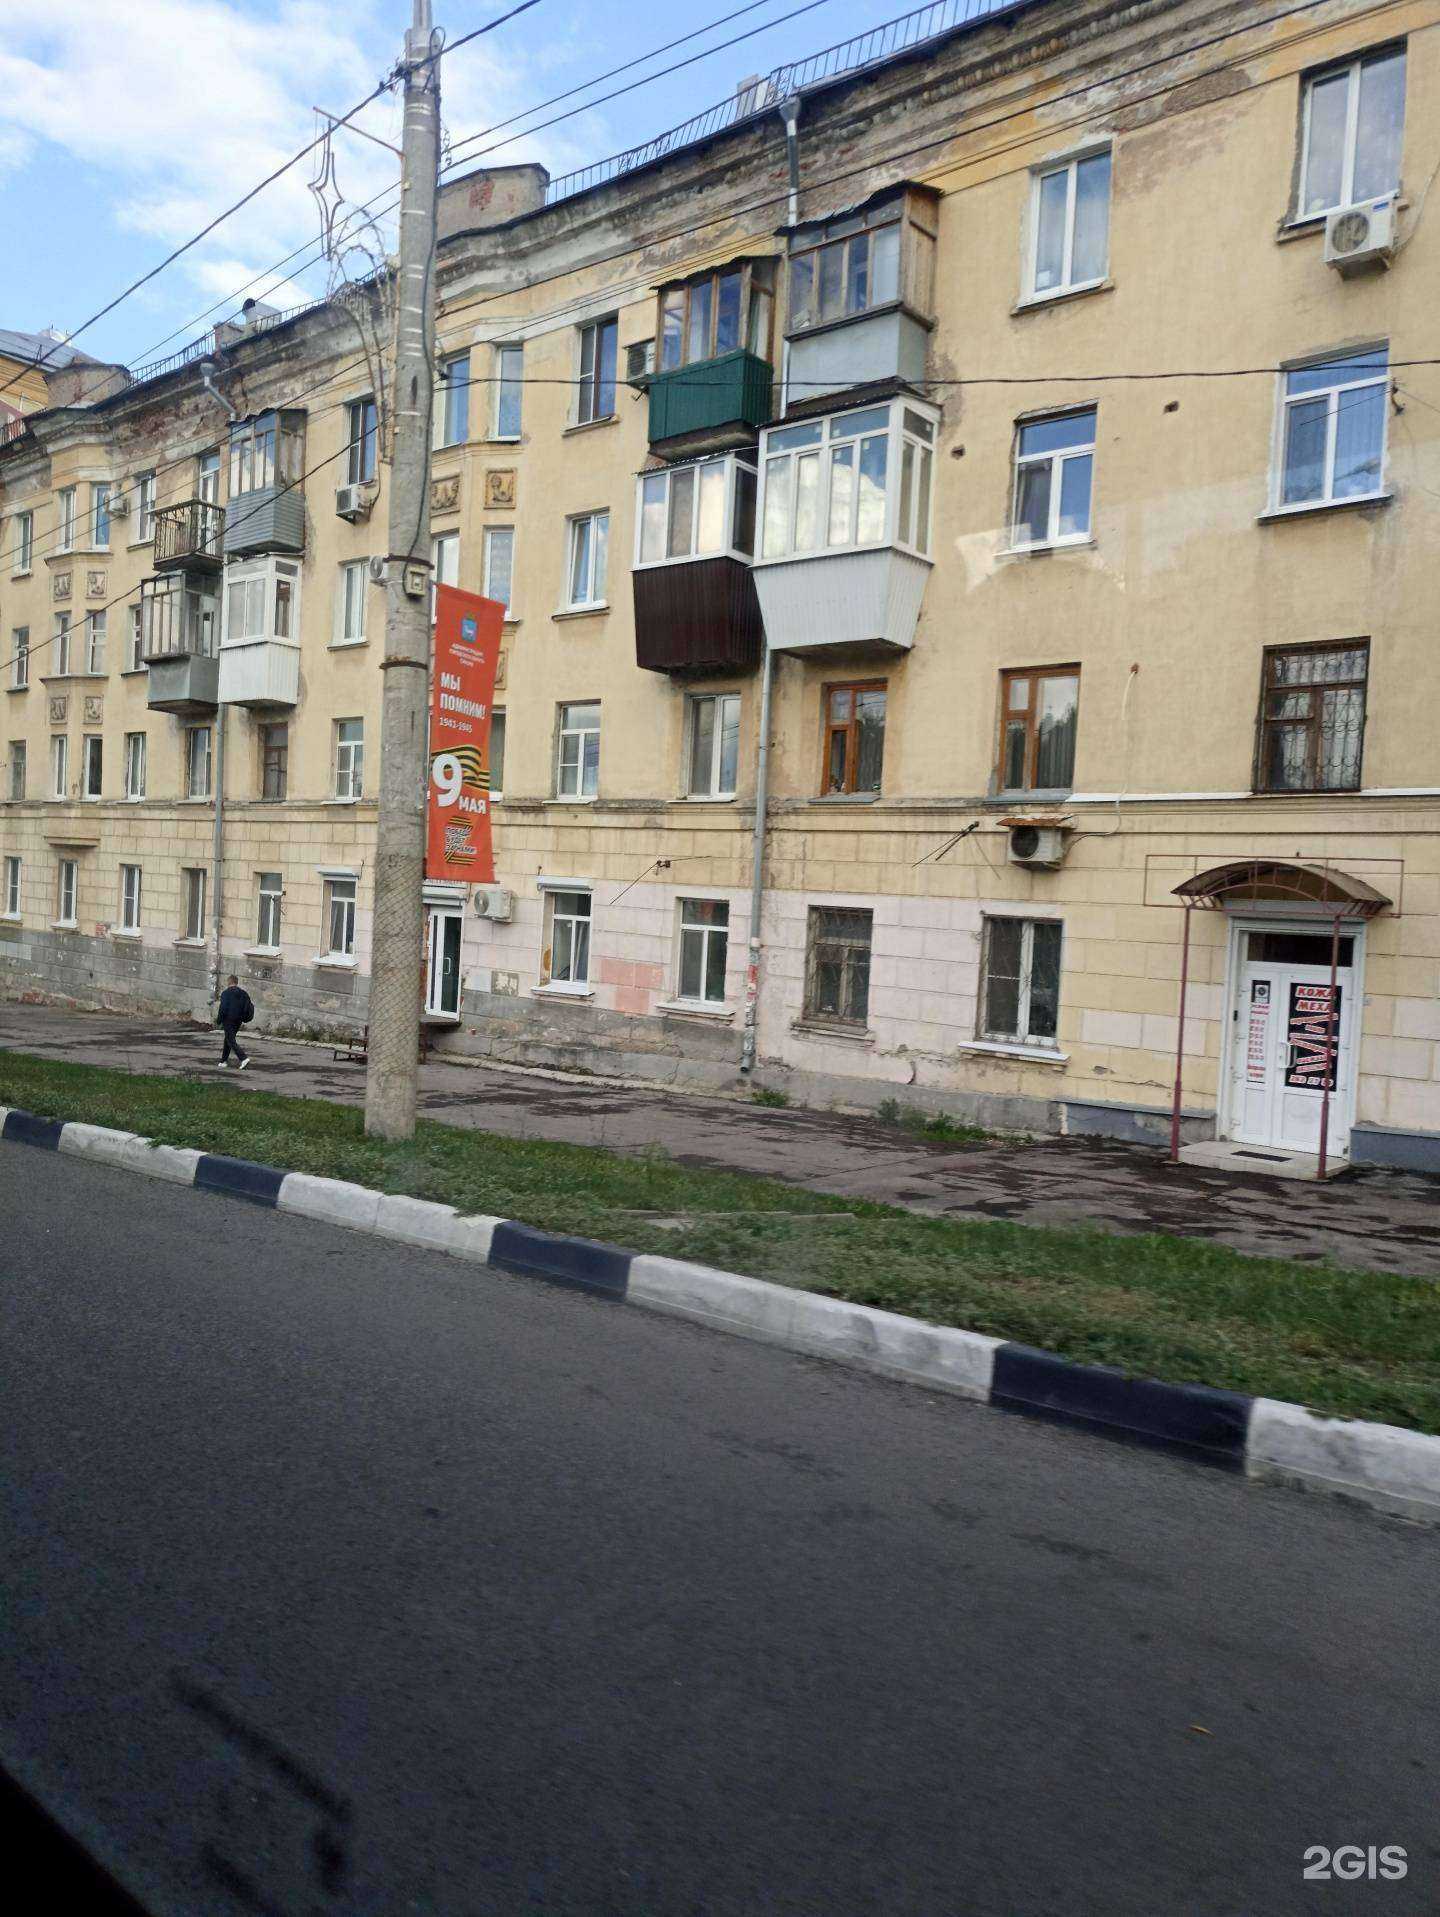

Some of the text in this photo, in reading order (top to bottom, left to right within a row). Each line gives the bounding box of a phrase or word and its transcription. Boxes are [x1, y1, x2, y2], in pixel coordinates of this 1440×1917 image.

[441, 671, 460, 691] МЫ
[440, 693, 486, 719] ПОМНИМ!
[432, 753, 487, 815] 9 МАЯ
